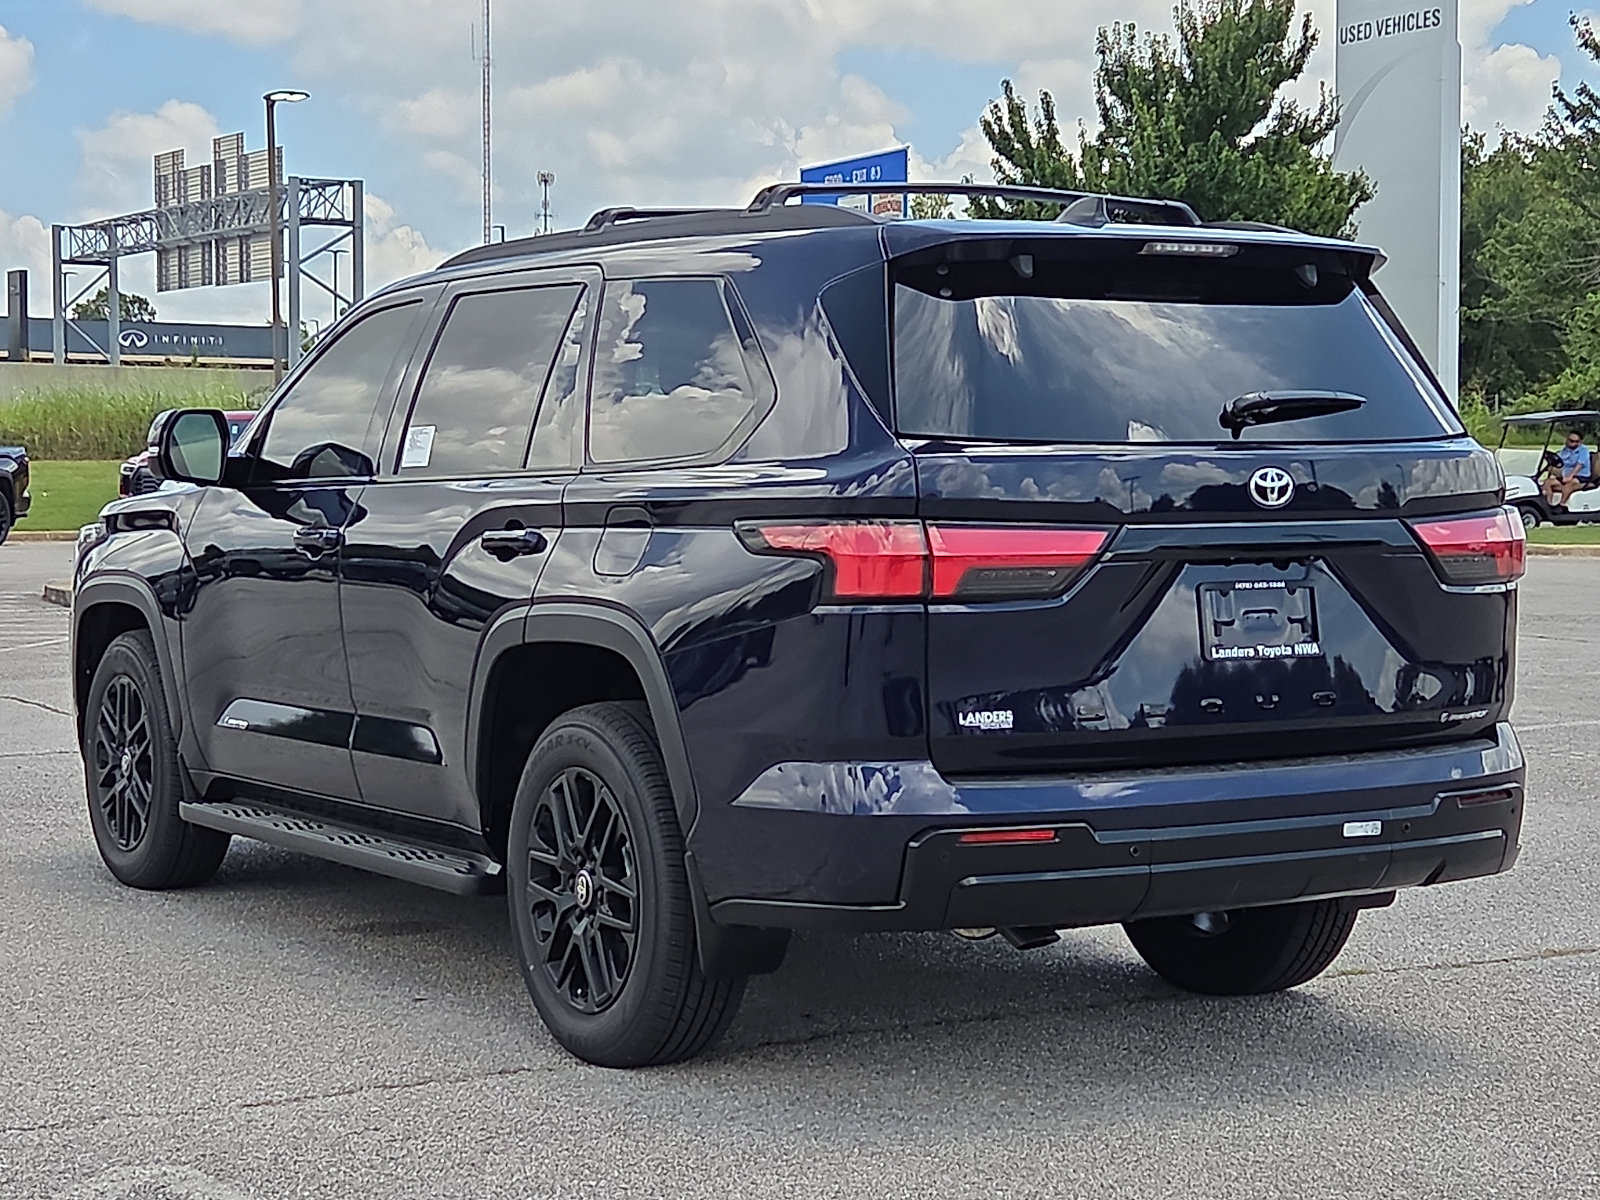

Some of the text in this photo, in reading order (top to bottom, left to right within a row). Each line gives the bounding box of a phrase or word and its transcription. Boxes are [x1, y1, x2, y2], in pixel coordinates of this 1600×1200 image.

[1340, 8, 1441, 45] USED VEHICLES
[154, 334, 224, 346] INFINITI
[1211, 642, 1320, 658] Landers Toyota NWA
[959, 710, 1013, 725] LANDERS
